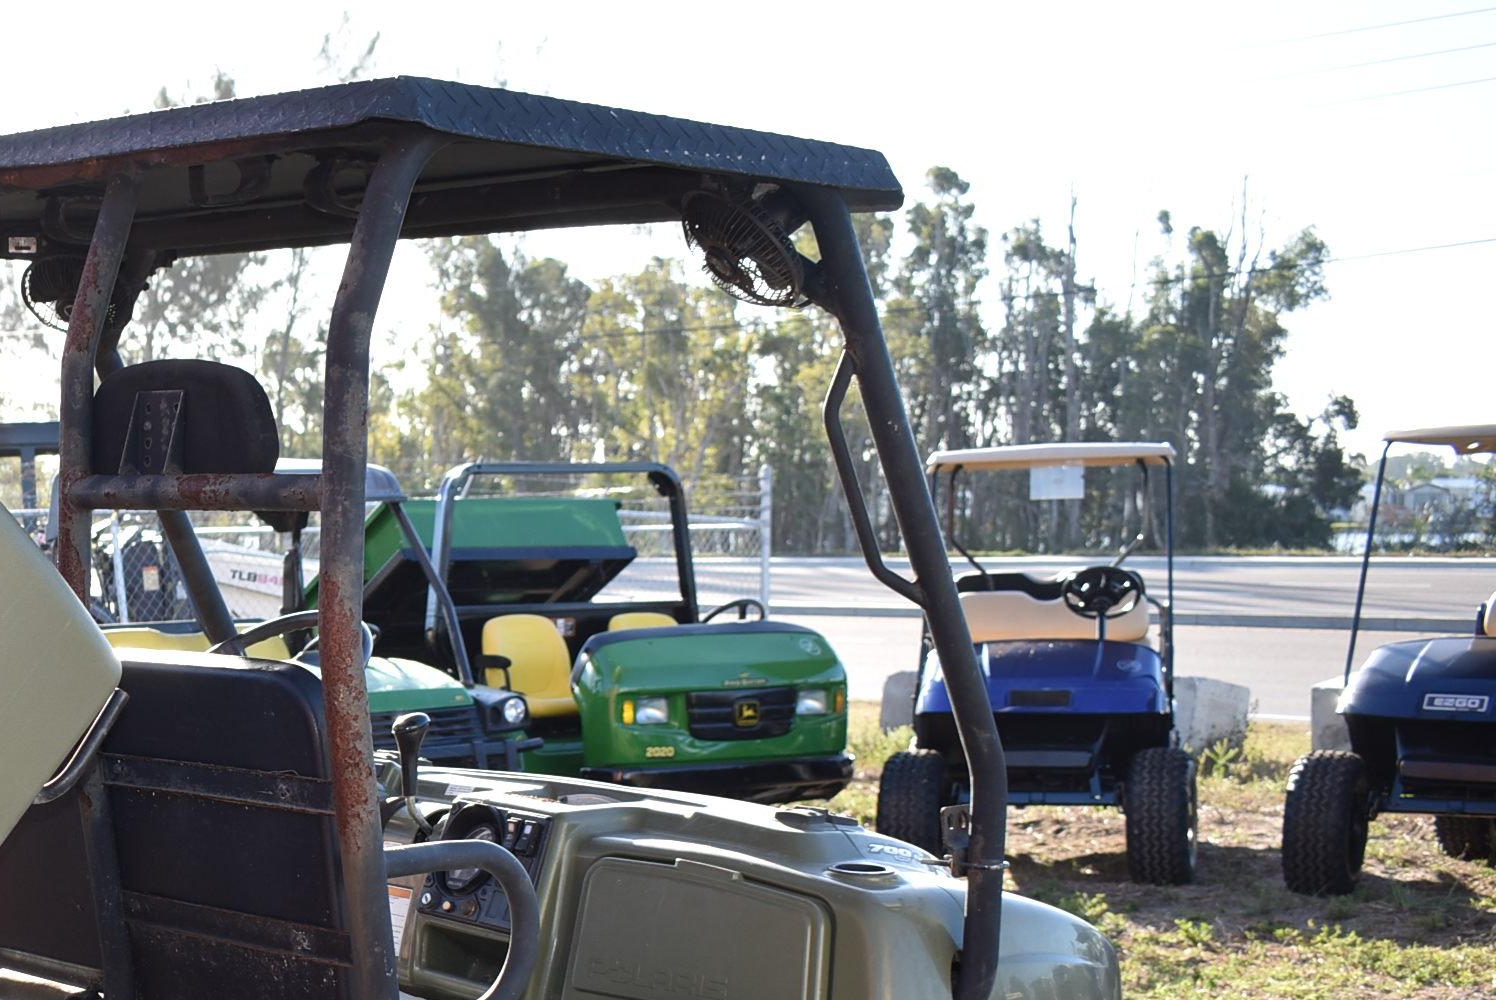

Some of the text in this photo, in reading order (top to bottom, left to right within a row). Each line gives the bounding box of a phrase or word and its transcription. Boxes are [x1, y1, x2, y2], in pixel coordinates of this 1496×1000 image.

[645, 746, 675, 758] 2020
[868, 843, 912, 859] 700
[588, 958, 729, 1000] POLARIS
